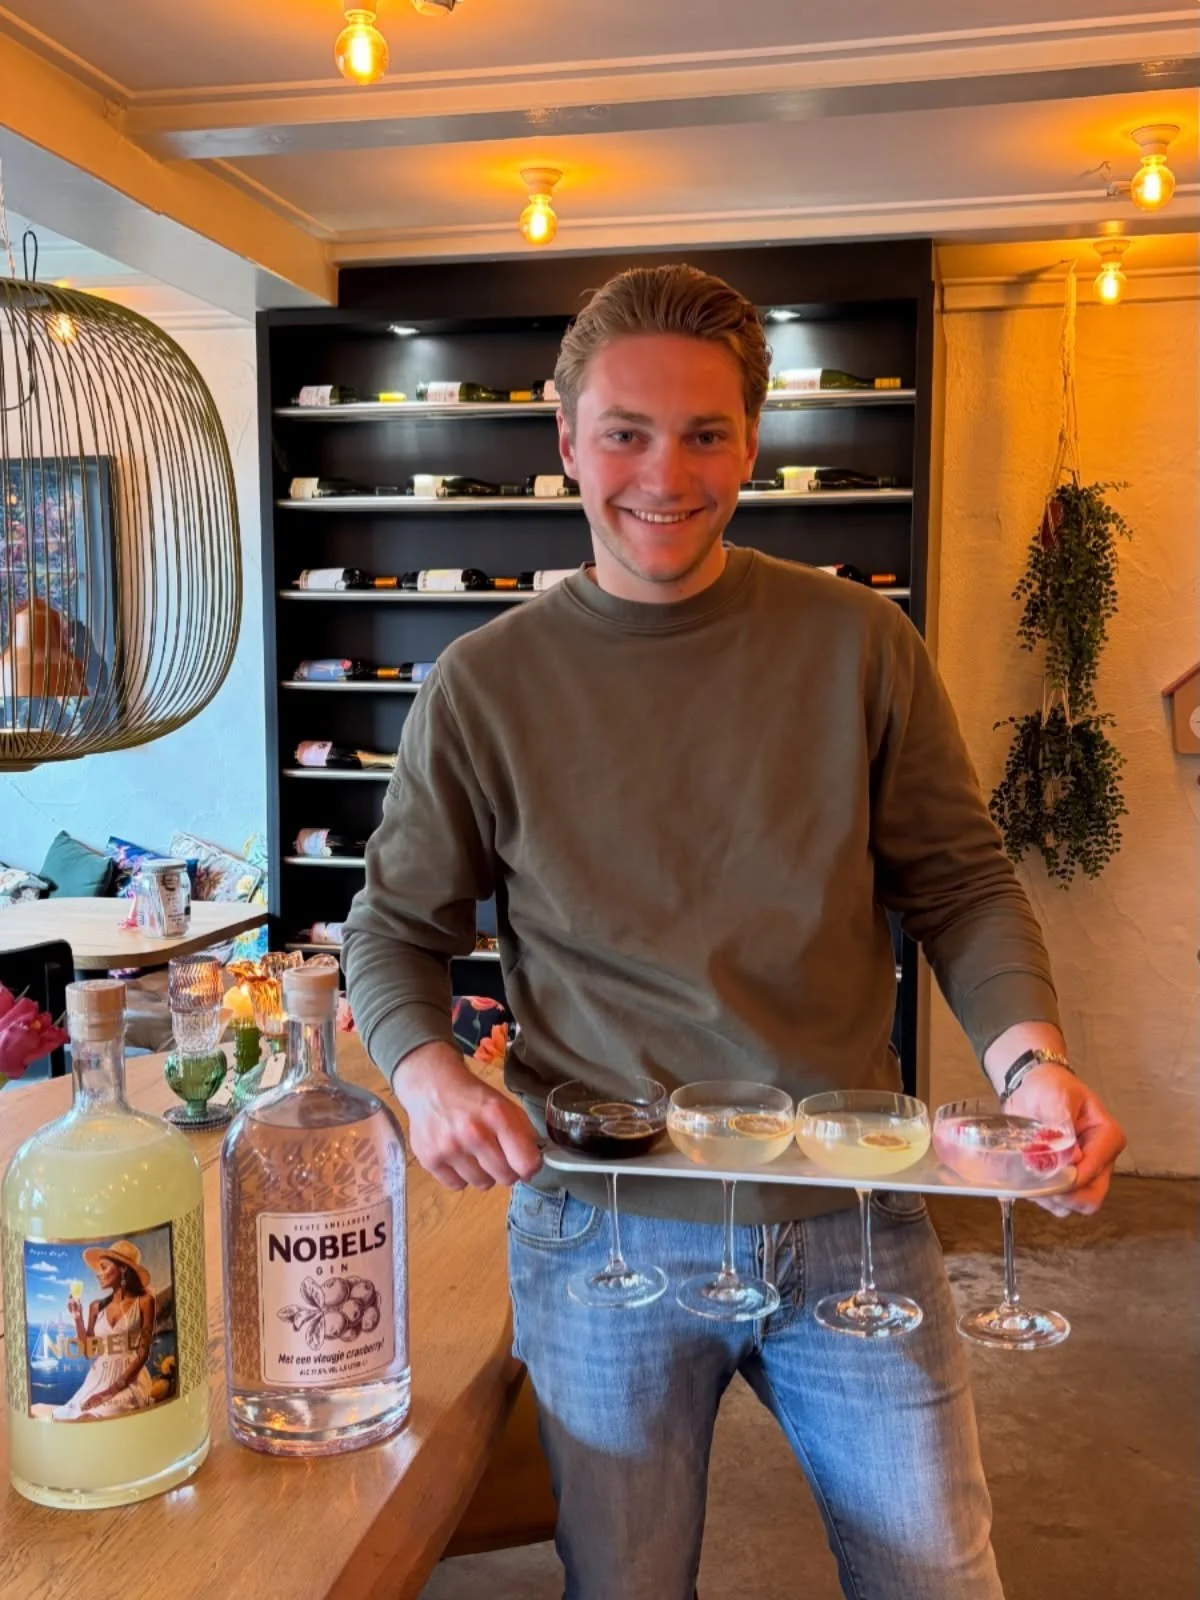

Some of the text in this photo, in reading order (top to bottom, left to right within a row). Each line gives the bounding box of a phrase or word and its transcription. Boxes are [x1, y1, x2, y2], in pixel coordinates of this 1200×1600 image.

[268, 1221, 387, 1263] NOBELS
[316, 1263, 348, 1276] GIN
[278, 1353, 294, 1364] Met
[295, 1356, 312, 1364] een
[313, 1350, 345, 1364] vleugje
